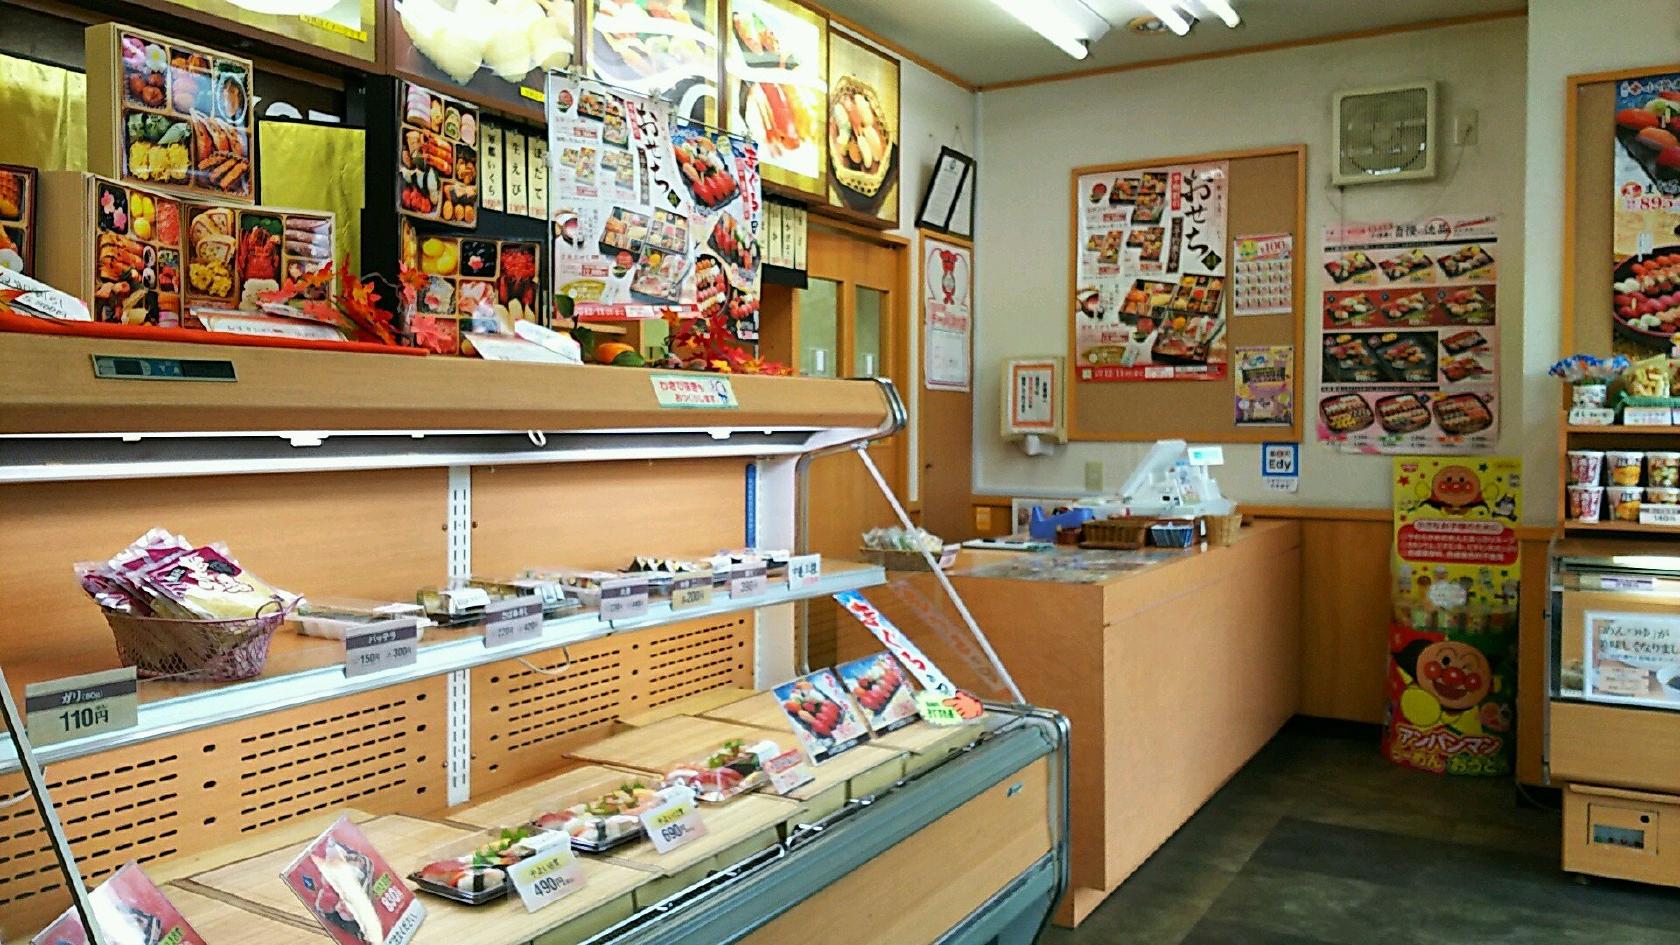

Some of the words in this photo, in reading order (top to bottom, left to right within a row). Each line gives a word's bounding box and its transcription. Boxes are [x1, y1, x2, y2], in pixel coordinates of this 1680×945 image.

[637, 102, 670, 193] おせち
[1182, 169, 1214, 258] おせち
[1269, 459, 1292, 471] Edy
[59, 707, 109, 732] 110円
[1399, 726, 1500, 754] アンパンマン
[661, 823, 686, 842] 690円
[534, 876, 564, 897] 490円
